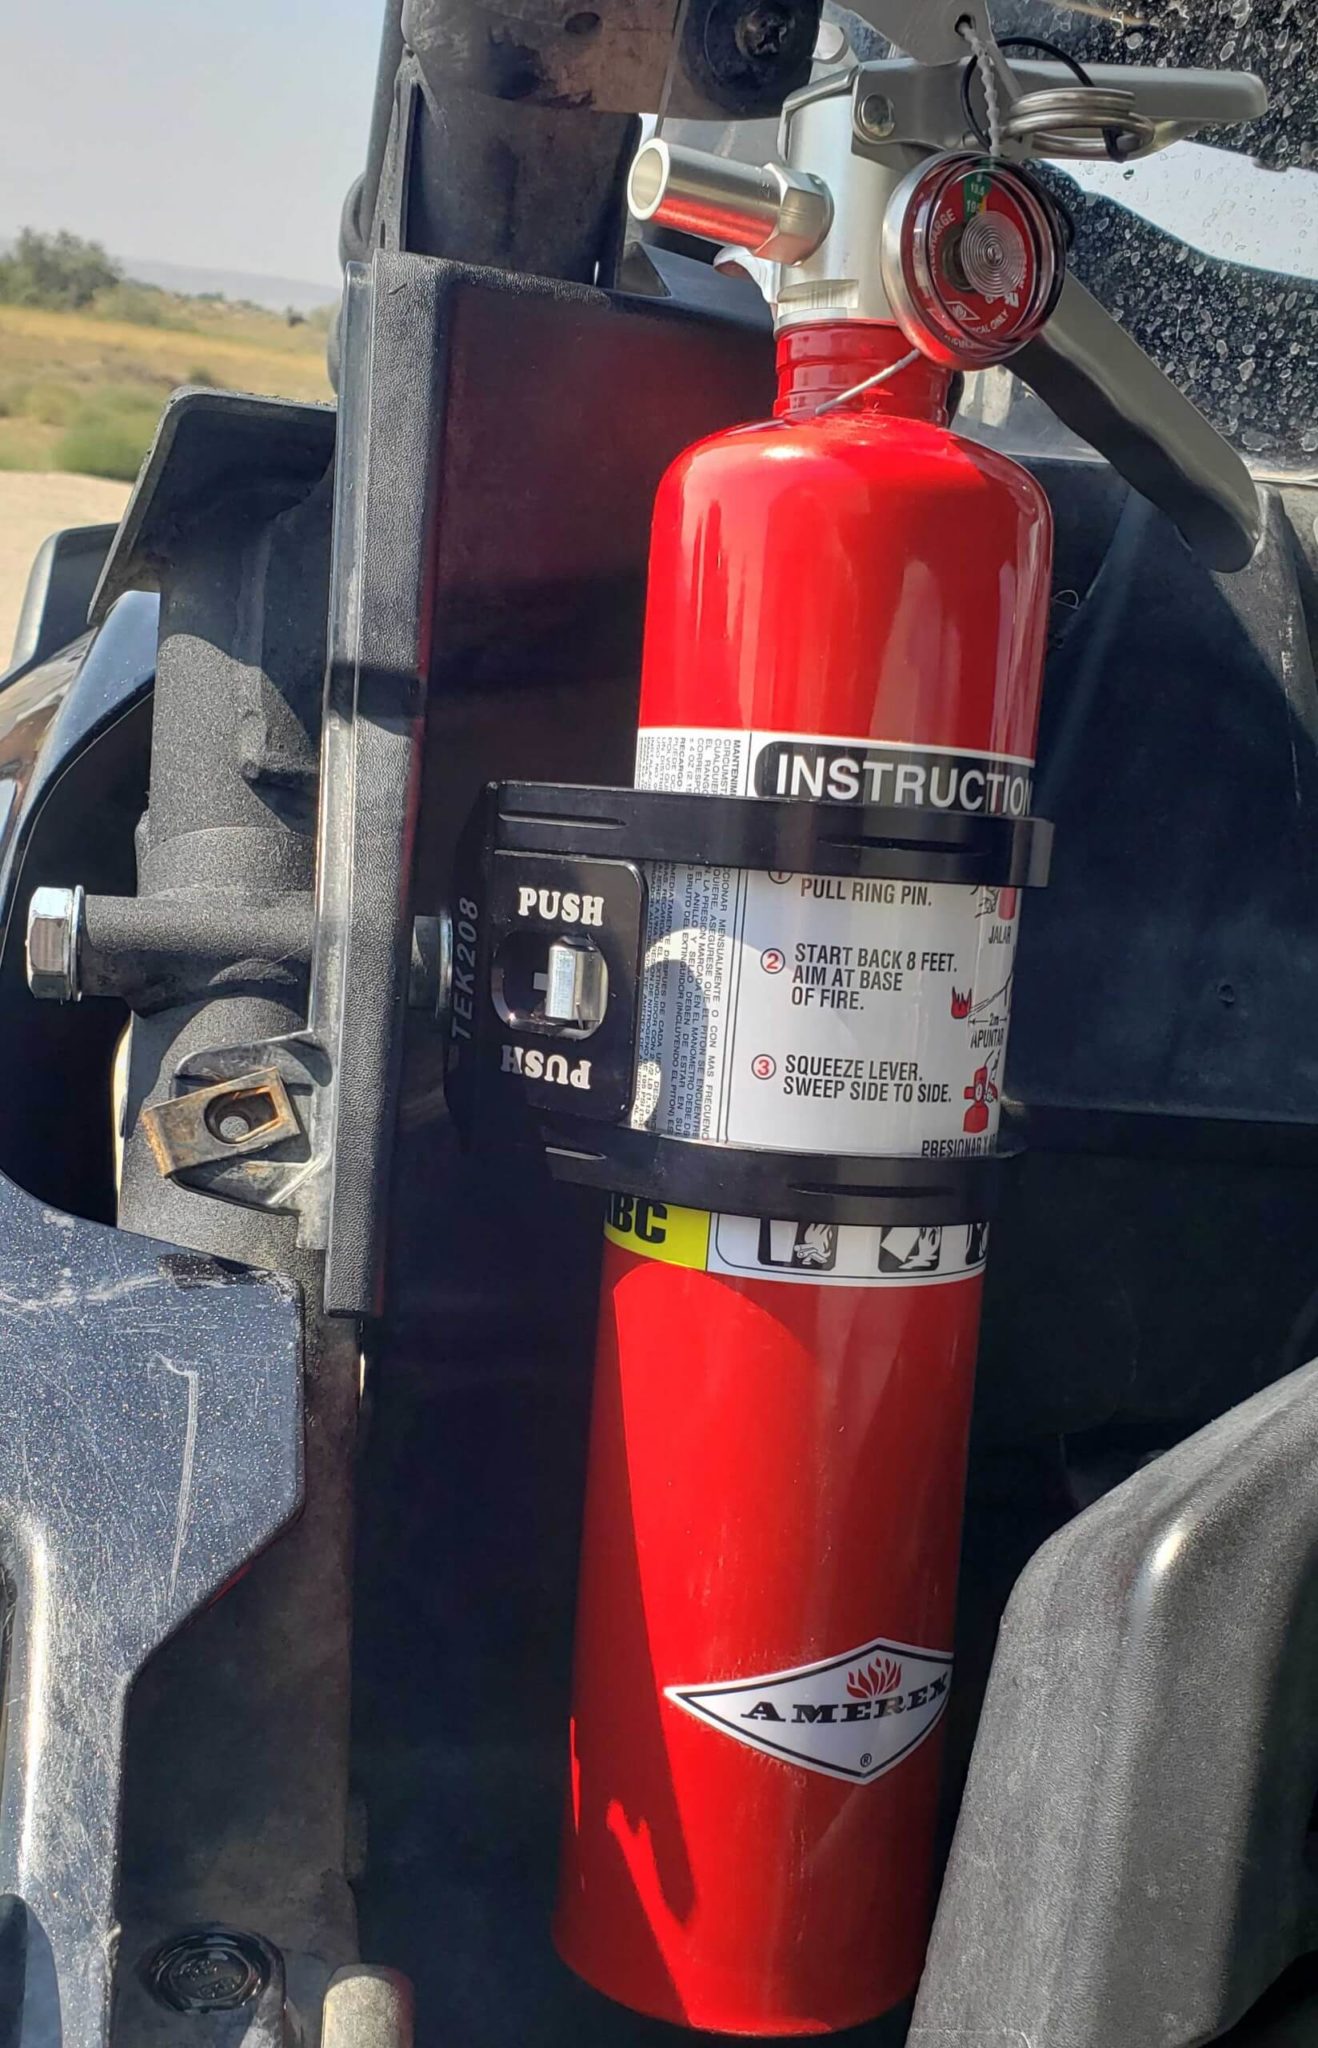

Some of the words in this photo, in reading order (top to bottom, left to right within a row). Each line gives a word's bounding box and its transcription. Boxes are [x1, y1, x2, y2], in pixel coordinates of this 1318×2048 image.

[990, 308, 1009, 331] ONLY
[800, 878, 846, 901] PULL
[852, 881, 895, 905] RING
[900, 885, 932, 906] PIN.
[518, 887, 604, 926] PUSH
[700, 896, 709, 940] PRESION
[988, 925, 1011, 945] JALAR
[452, 897, 480, 1041] TEK208
[713, 920, 726, 1002] MENSUALMENTE
[795, 943, 853, 967] START
[857, 948, 903, 970] BACK
[906, 951, 916, 970] 8
[920, 952, 958, 972] FEET.
[703, 981, 711, 1003] QUE
[792, 966, 826, 987] AIM
[831, 968, 855, 989] AT
[860, 969, 903, 992] BASE
[694, 995, 701, 1008] EN
[791, 986, 815, 1007] OF
[820, 988, 864, 1010] FIRE.
[692, 1012, 700, 1024] EL
[710, 1025, 718, 1048] CON
[970, 1029, 1004, 1049] APUNTAR
[500, 1045, 592, 1089] PUSH
[785, 1055, 863, 1080] SQUEEZE
[868, 1060, 923, 1082] LEVER.
[783, 1077, 845, 1101] SWEEP
[849, 1081, 889, 1102] SIDE
[894, 1083, 913, 1103] TO
[917, 1084, 952, 1103] SIDE.
[740, 1672, 948, 1723] AMEREX
